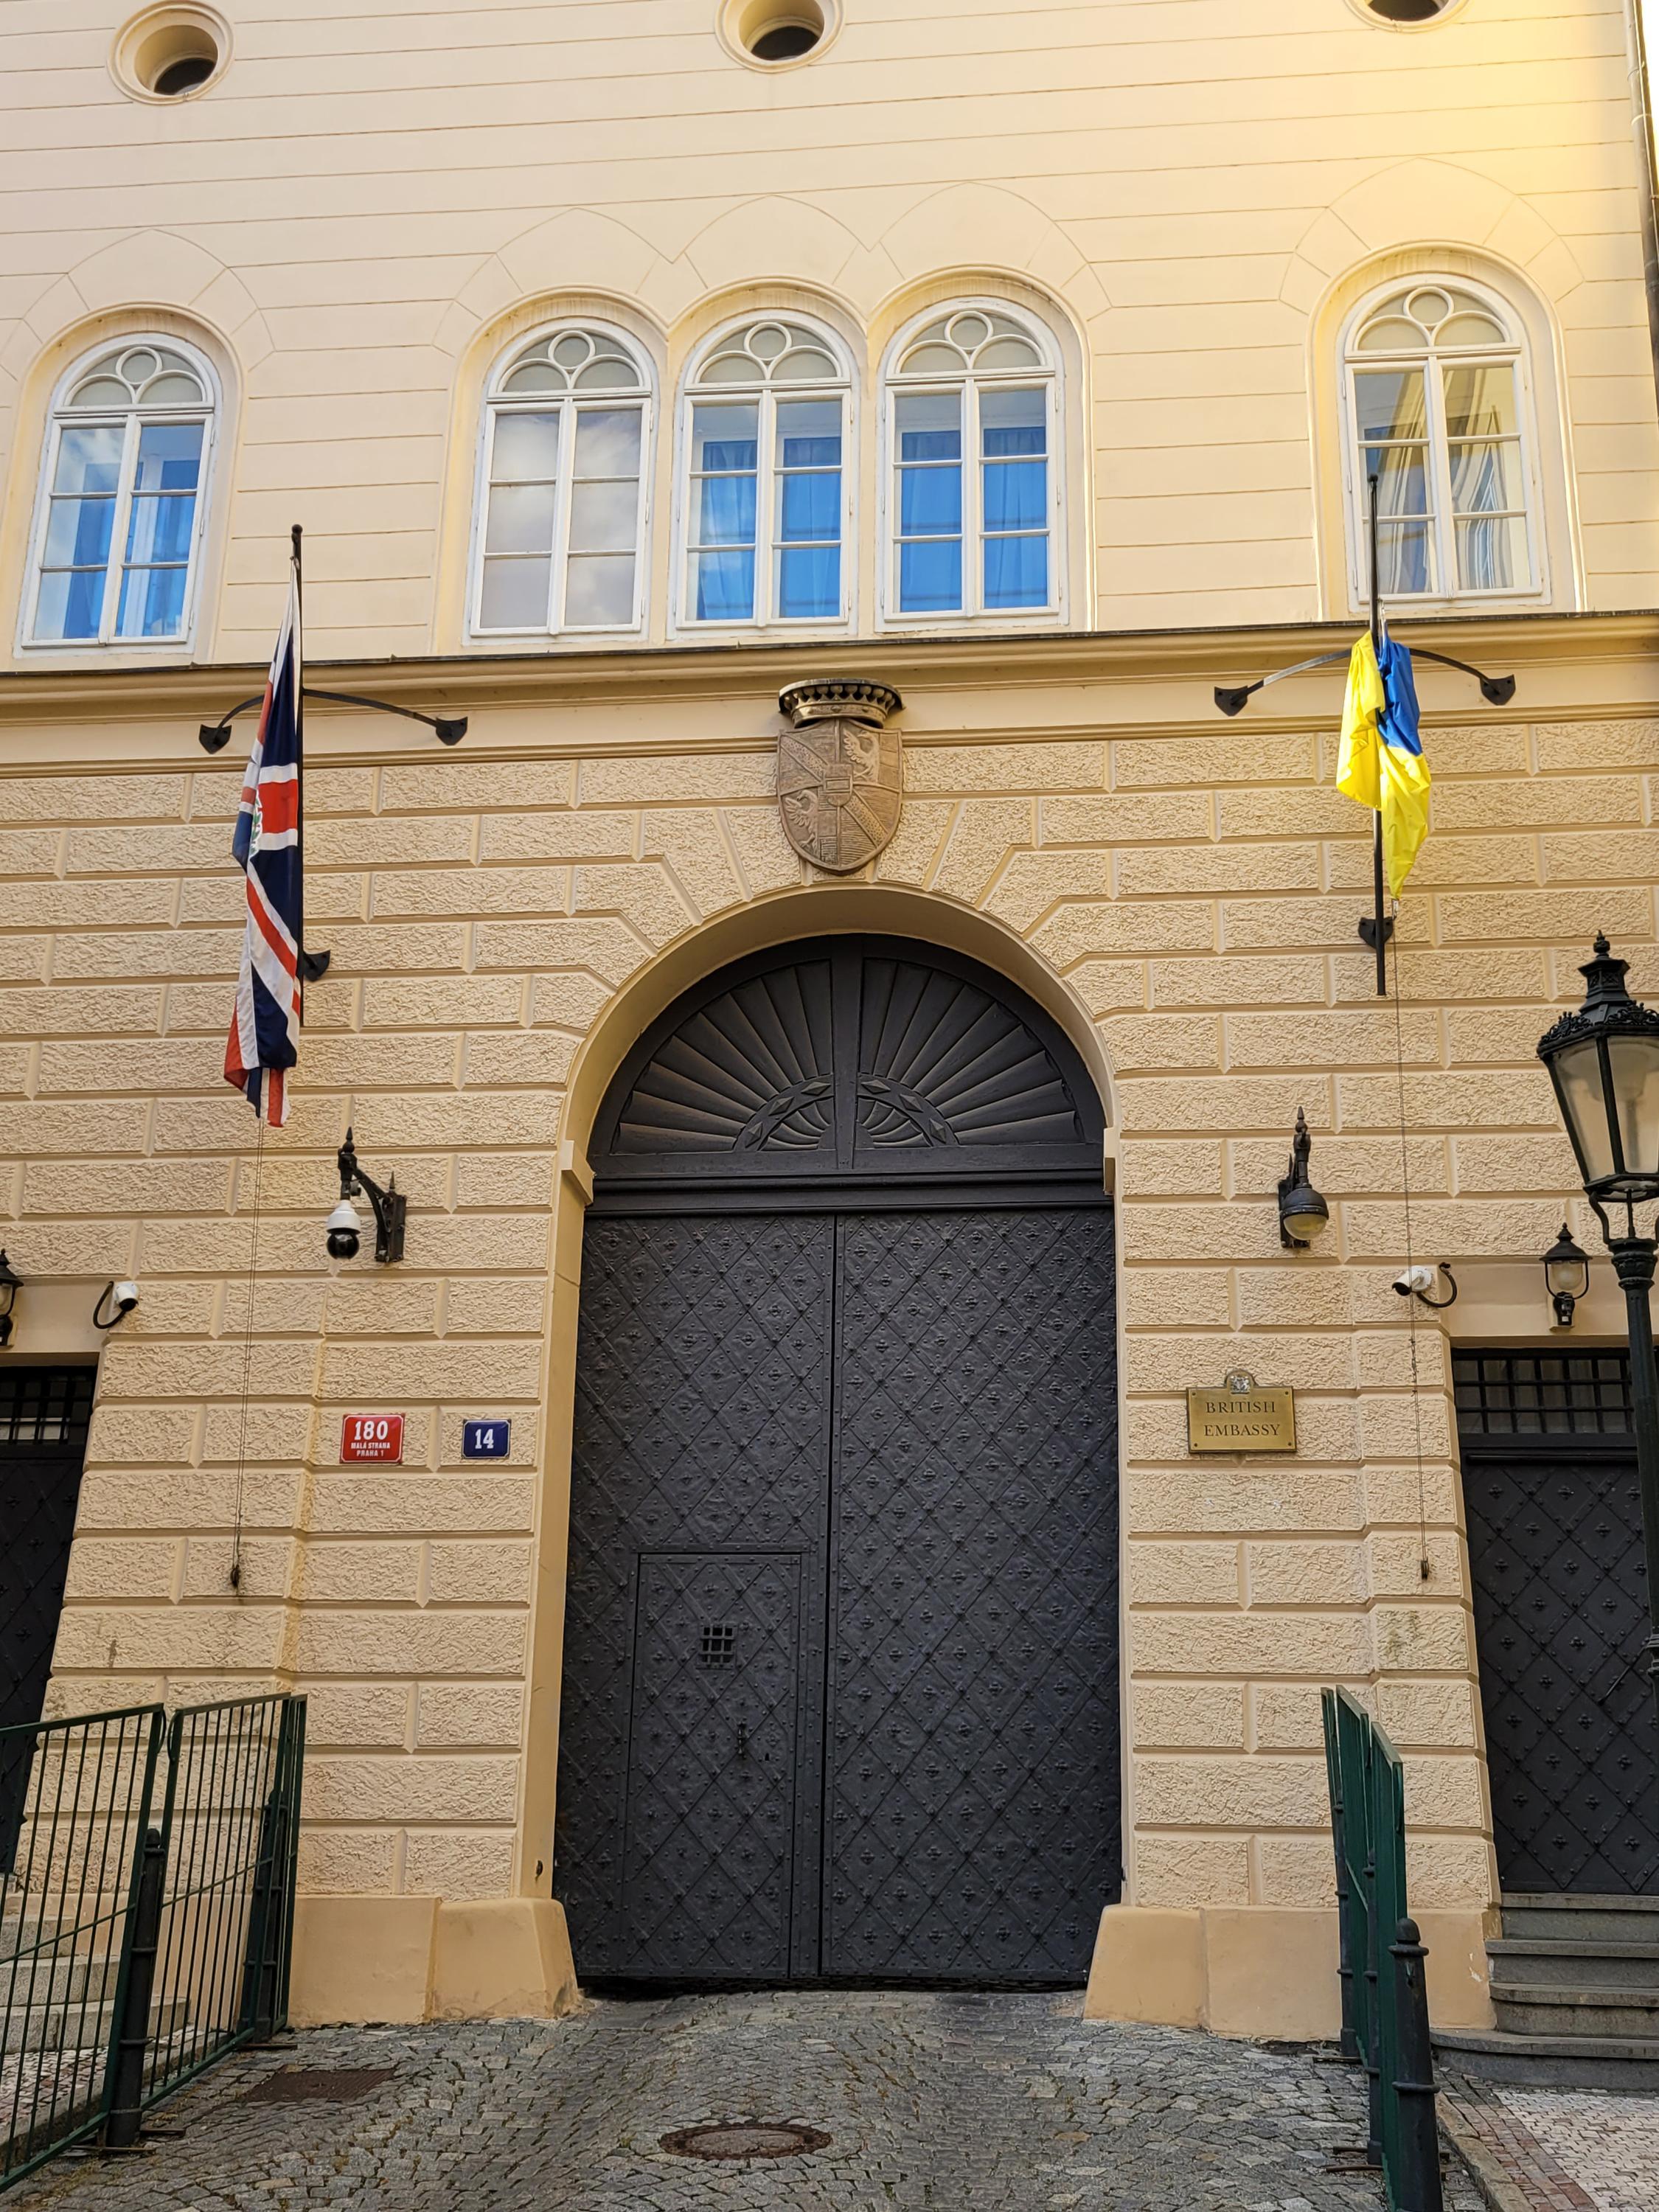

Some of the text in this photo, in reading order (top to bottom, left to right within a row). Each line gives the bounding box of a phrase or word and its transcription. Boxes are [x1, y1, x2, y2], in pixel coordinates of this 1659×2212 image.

[1206, 1401, 1276, 1413] BRITISH
[354, 1420, 389, 1441] 180
[1204, 1424, 1280, 1436] EMBASSY
[475, 1428, 494, 1450] 14
